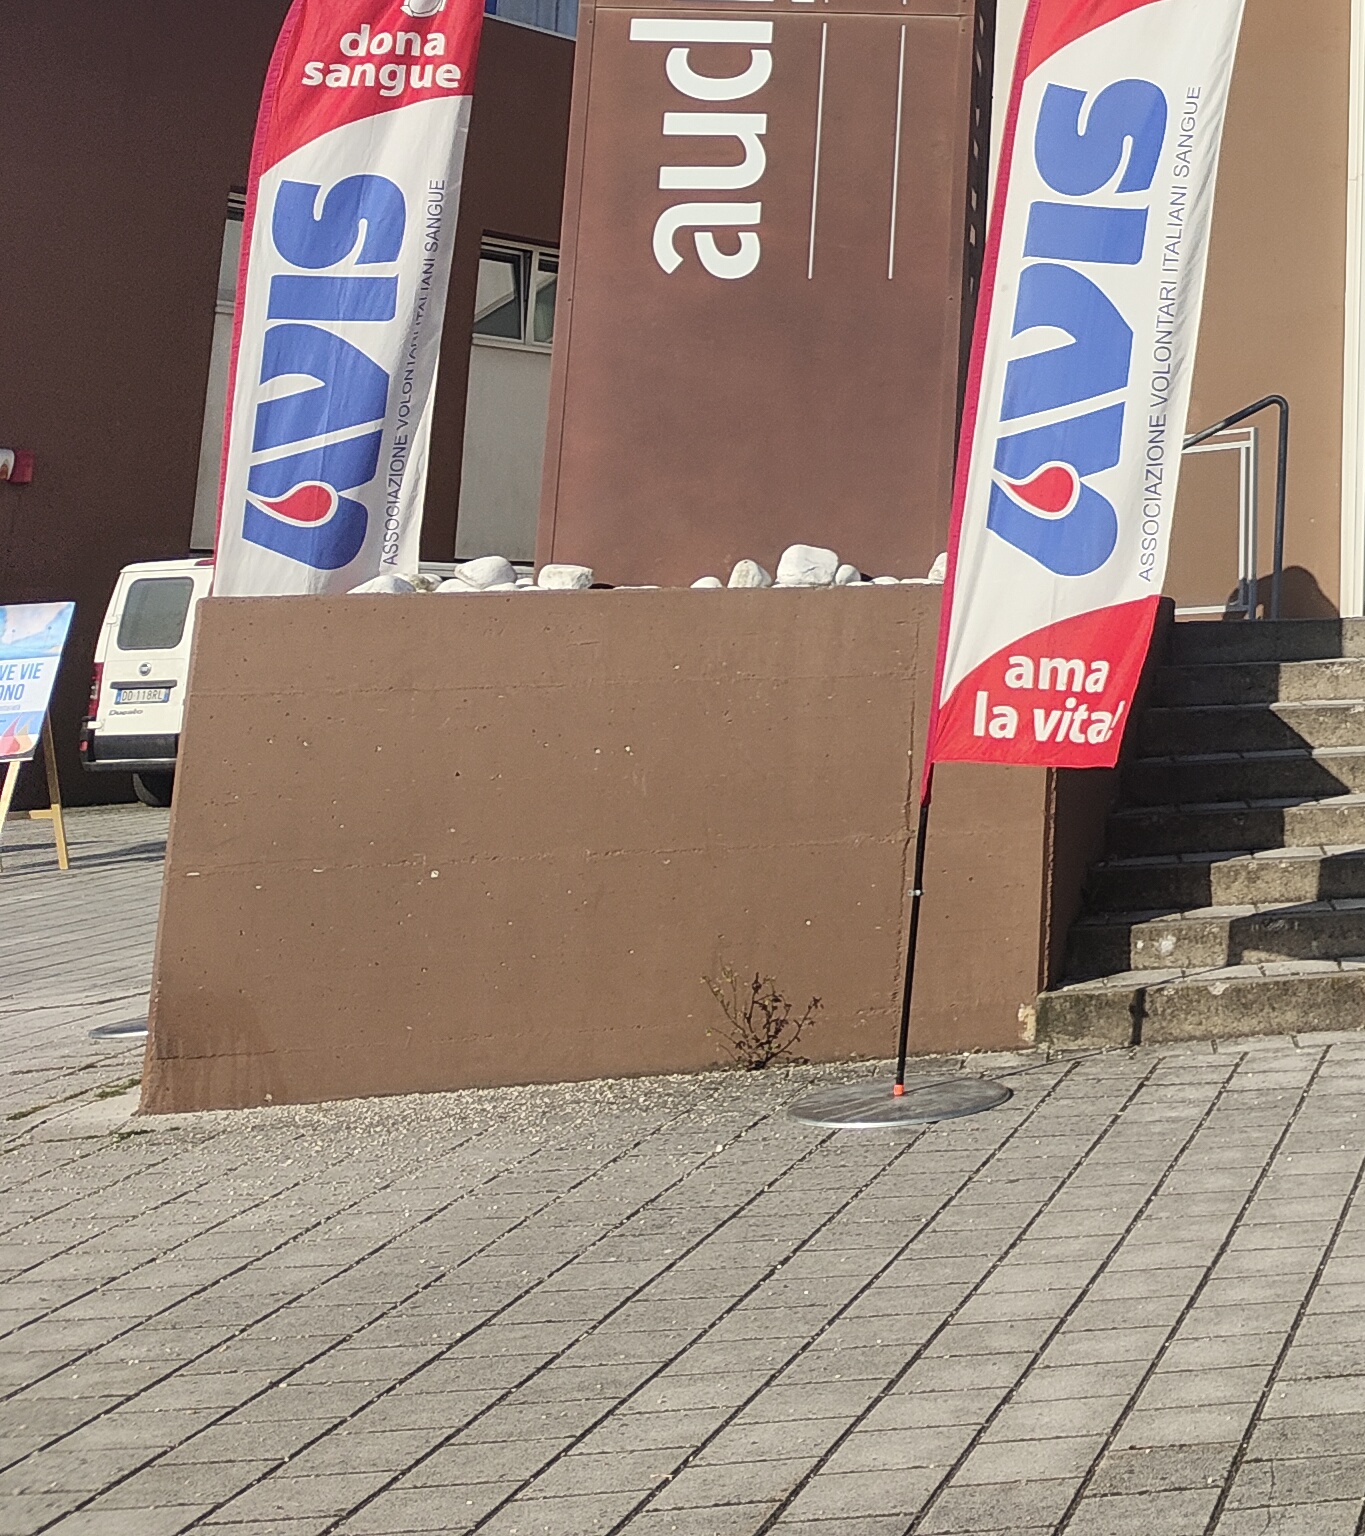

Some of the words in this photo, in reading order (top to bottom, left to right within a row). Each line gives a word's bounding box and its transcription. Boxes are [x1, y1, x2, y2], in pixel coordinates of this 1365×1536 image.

[302, 60, 462, 96] sangue
[340, 23, 446, 57] dona
[1173, 85, 1201, 179] SANGUE
[1162, 184, 1188, 272] ITALIANI
[242, 173, 407, 570] AVIS
[382, 434, 410, 566] ASSOCIAZIONE
[424, 178, 446, 253] SANGUE
[987, 77, 1168, 578] AVIS
[1149, 276, 1177, 407] VOLONTARI
[1140, 413, 1167, 582] ASSOCIAZIONE
[20, 662, 44, 680] VIE
[1005, 652, 1107, 694] ama
[973, 699, 1009, 740] la
